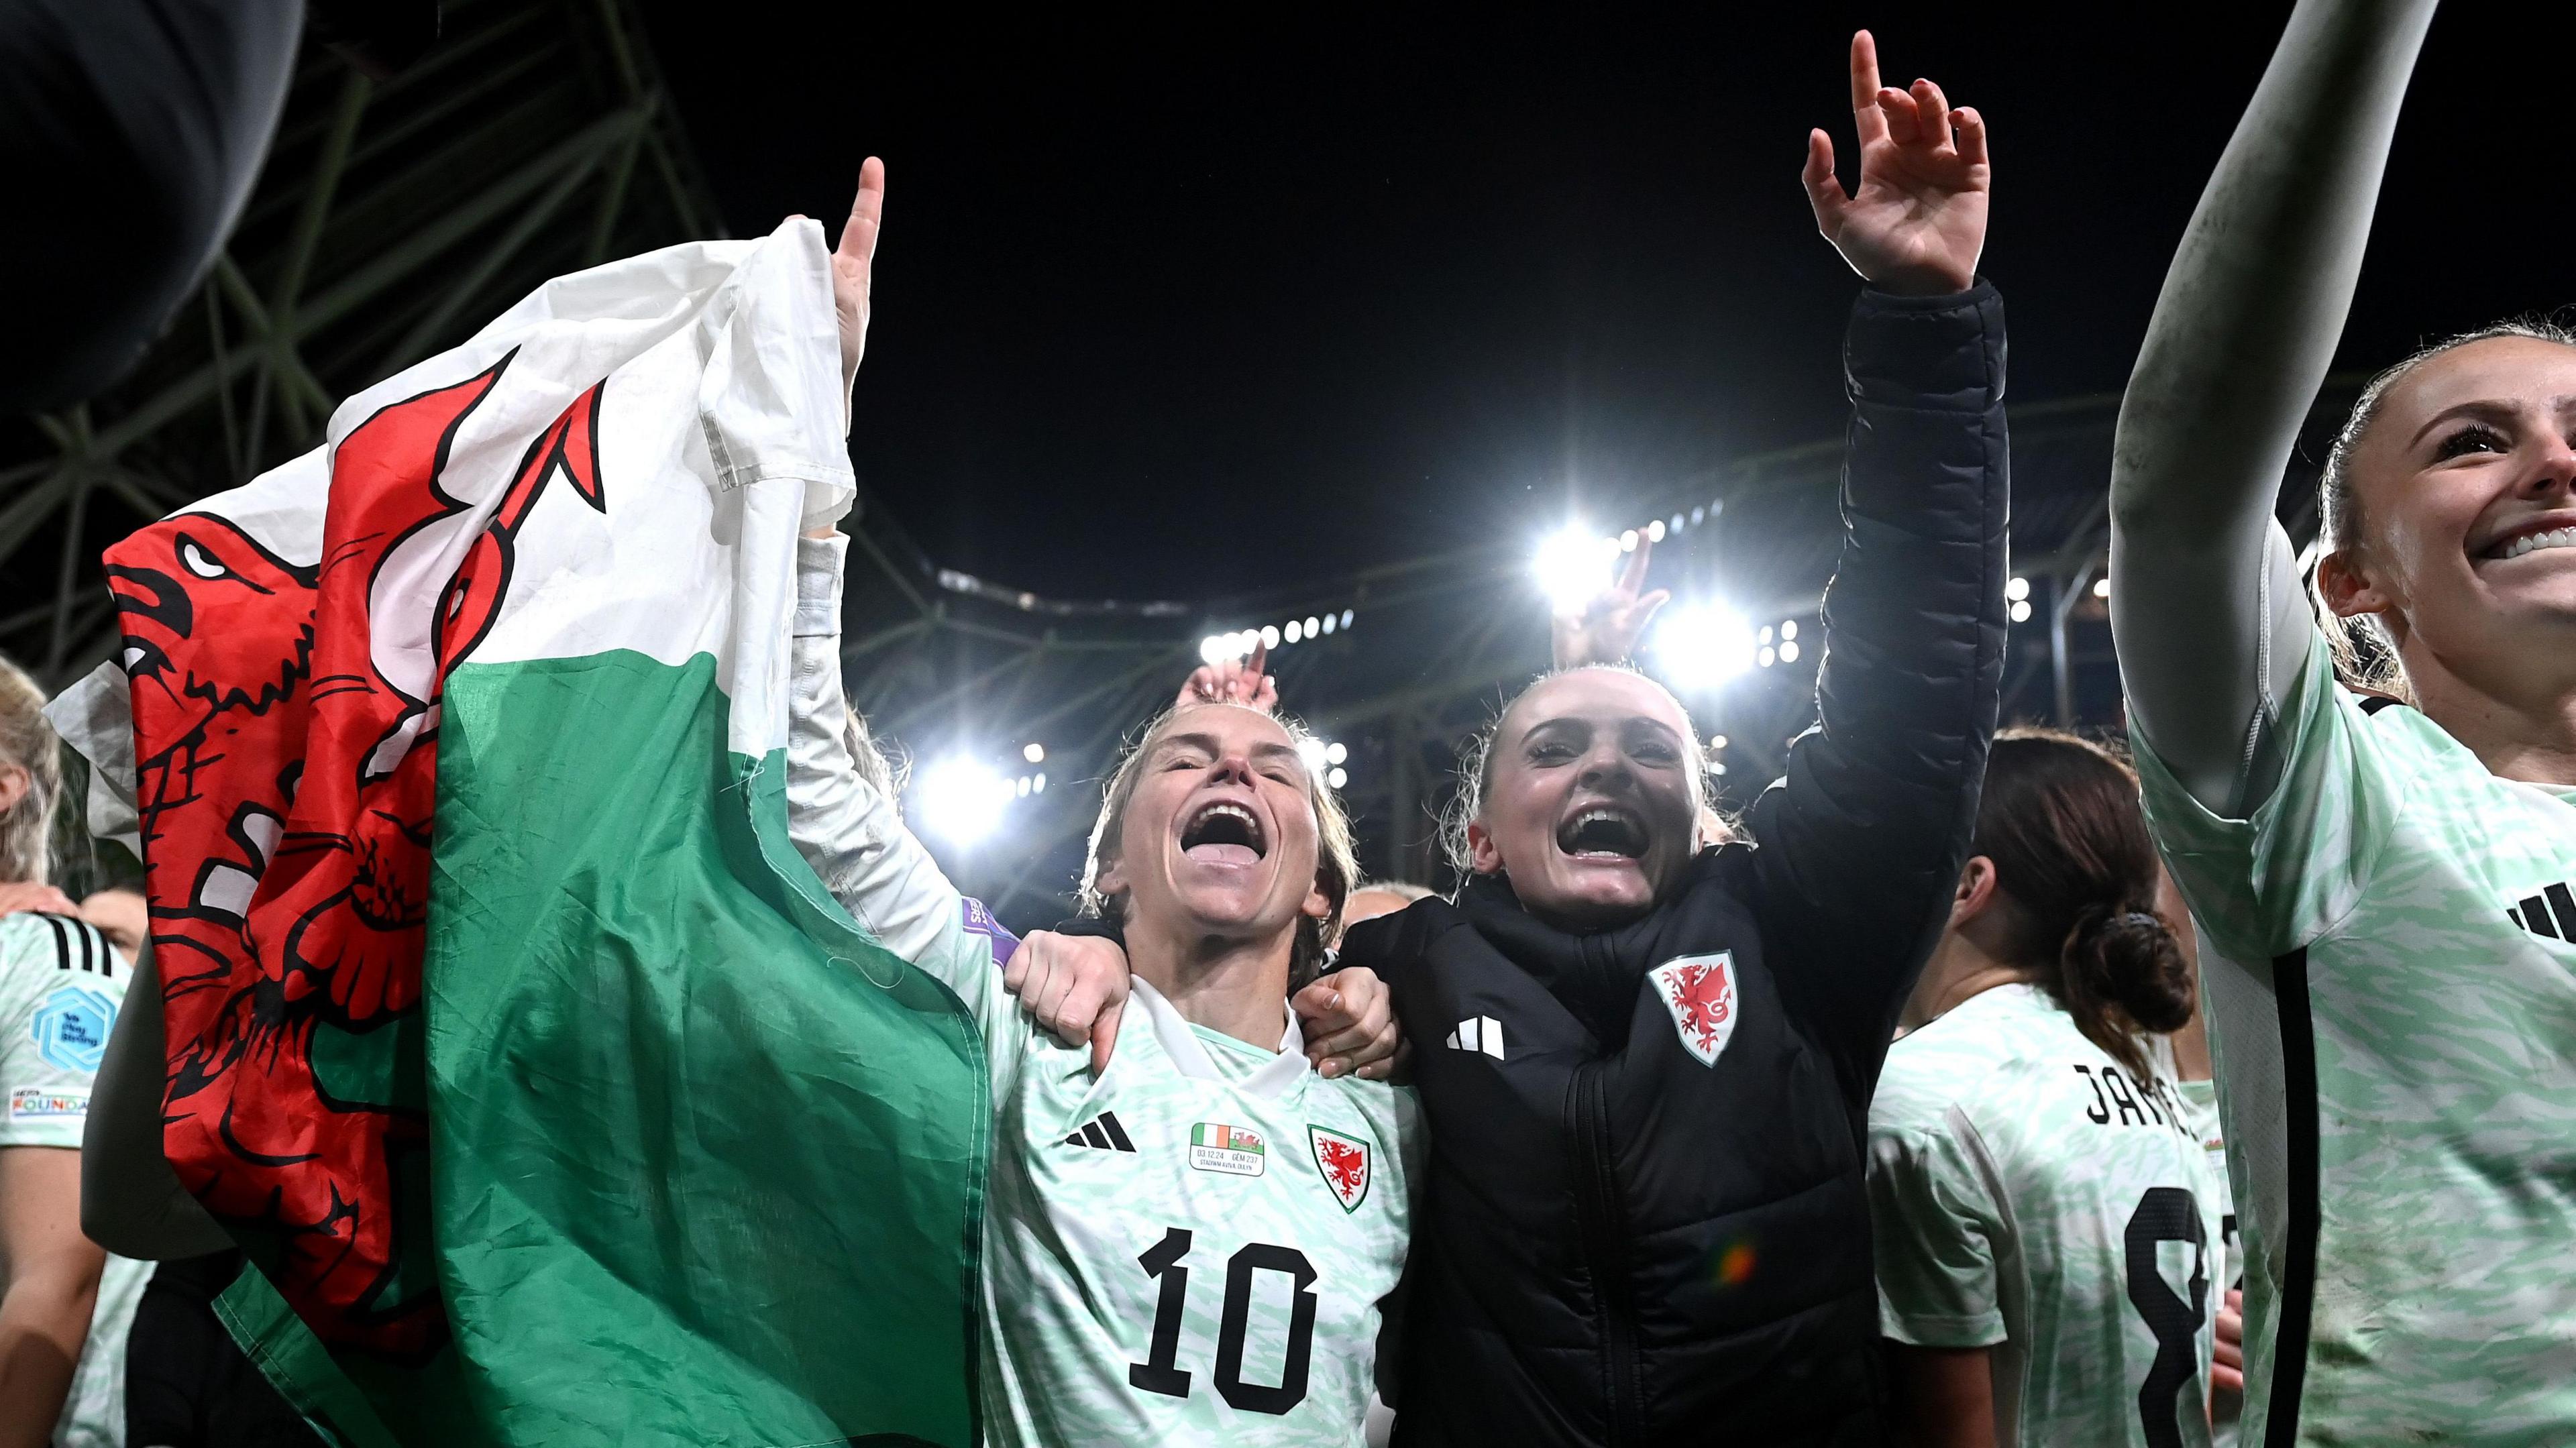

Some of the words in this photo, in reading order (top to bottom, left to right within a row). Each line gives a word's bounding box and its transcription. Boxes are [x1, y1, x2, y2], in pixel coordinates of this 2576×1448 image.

[13, 1097, 87, 1111] FOUNDA
[1246, 1155, 1258, 1164] 237
[1129, 1227, 1318, 1415] 10
